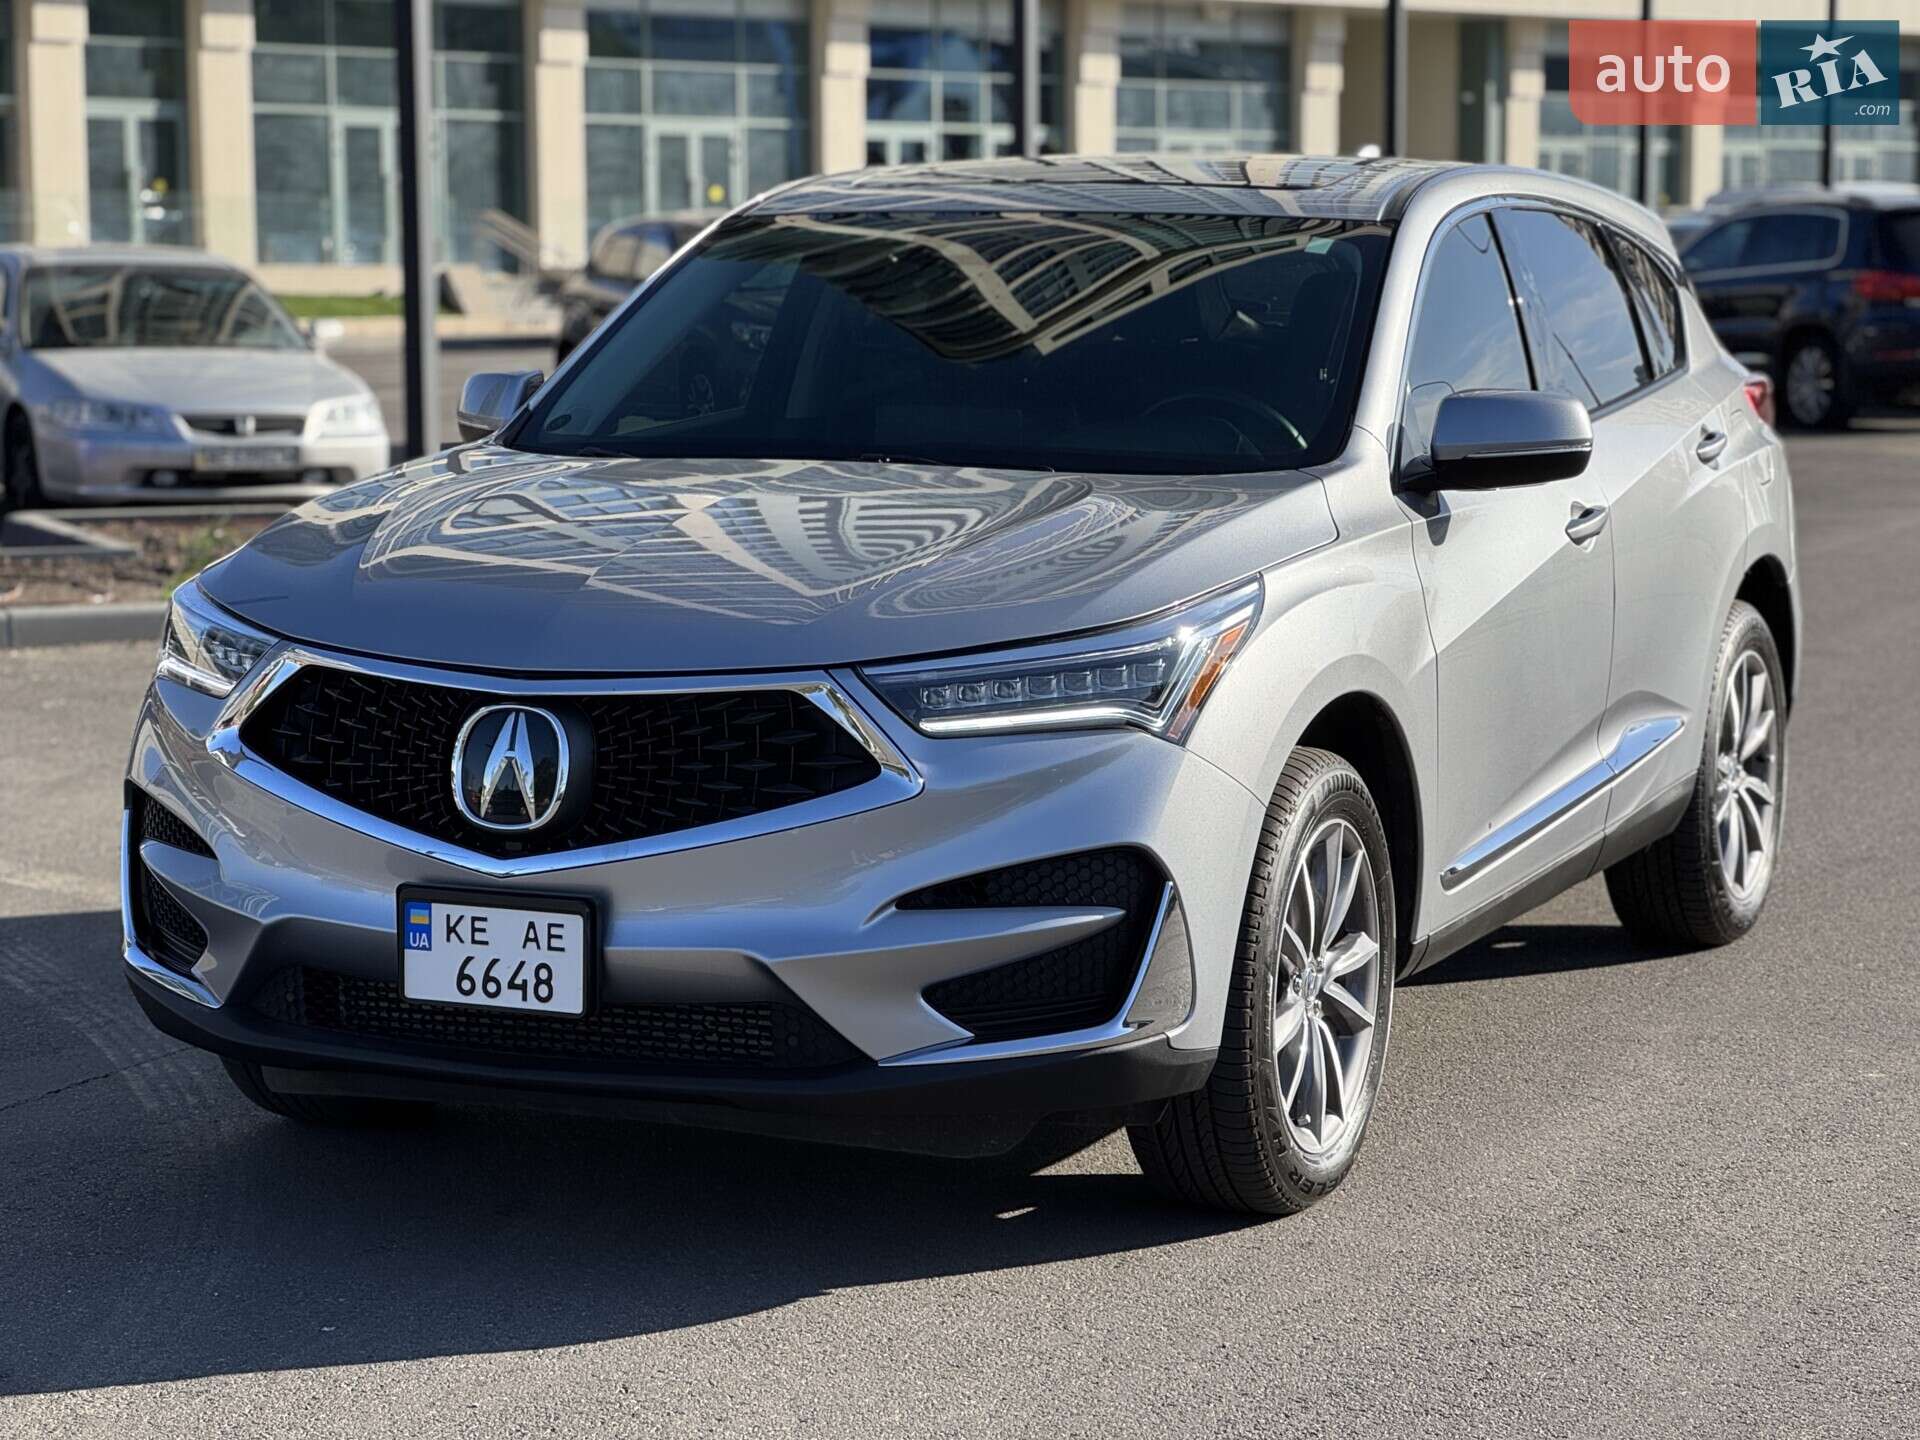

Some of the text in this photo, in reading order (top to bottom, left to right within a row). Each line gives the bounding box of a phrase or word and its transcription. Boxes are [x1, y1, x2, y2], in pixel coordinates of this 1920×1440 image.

[409, 932, 430, 949] UA
[446, 914, 566, 952] KE AE
[456, 956, 553, 1004] 6648
